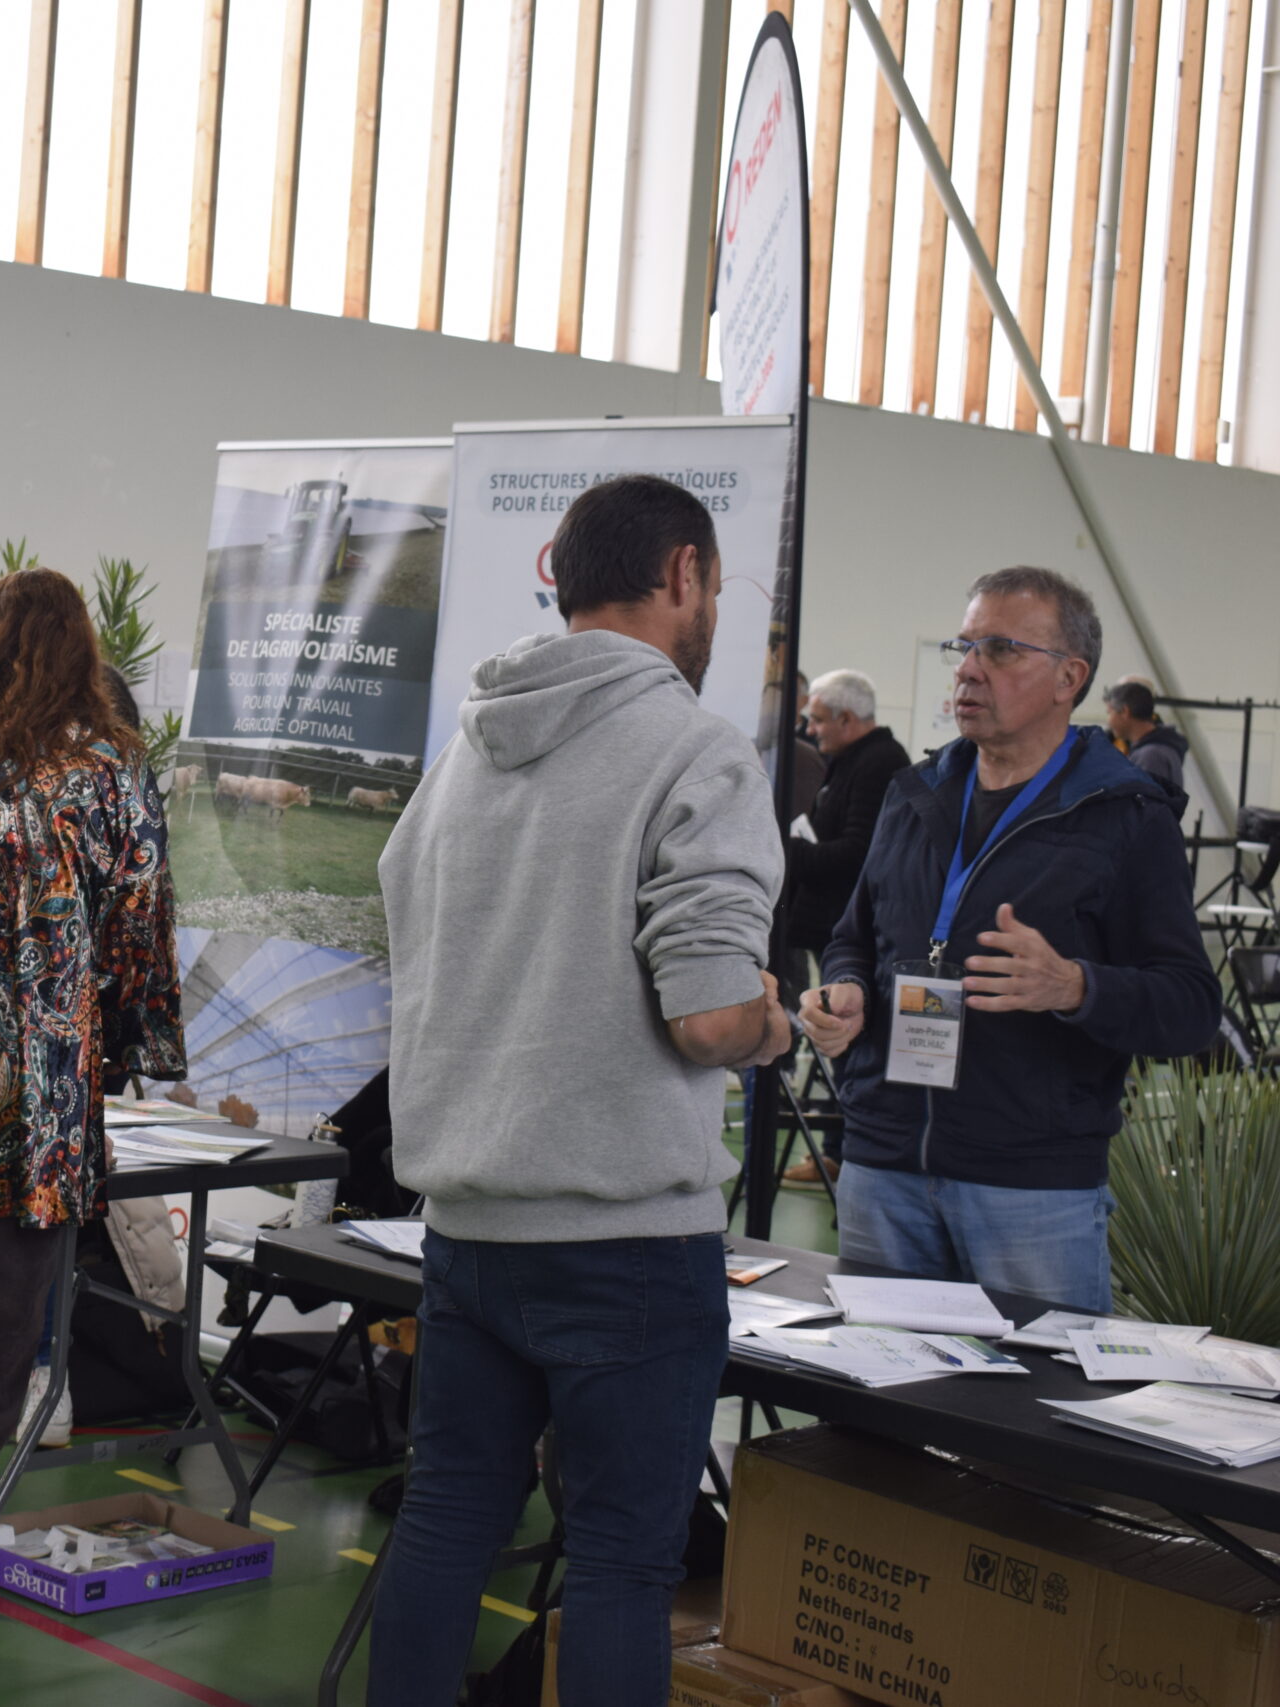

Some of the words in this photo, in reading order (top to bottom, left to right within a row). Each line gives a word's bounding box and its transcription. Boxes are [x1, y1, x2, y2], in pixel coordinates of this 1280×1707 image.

[489, 473, 587, 490] STRUCTURES
[492, 496, 536, 512] POUR
[263, 608, 363, 634] SPÉCIALISTE
[227, 639, 250, 659] DE
[251, 639, 398, 667] L'AGRIVOLTAÏSME
[227, 671, 288, 688] SOLUTIONS
[289, 672, 383, 697] INNOVANTES
[242, 695, 272, 710] POUR
[273, 695, 292, 710] UN
[296, 696, 353, 718] TRAVAIL
[233, 717, 285, 733] AGRICOLE
[287, 719, 356, 742] OPTIMAL
[804, 1533, 829, 1556] PF
[833, 1544, 931, 1594] CONCEPT
[3, 1562, 67, 1610] image
[801, 1559, 901, 1613] PO:662312
[798, 1585, 915, 1645] Netherlands
[792, 1636, 850, 1675] MADE
[854, 1660, 875, 1683] IN
[879, 1670, 943, 1707] CHINA
